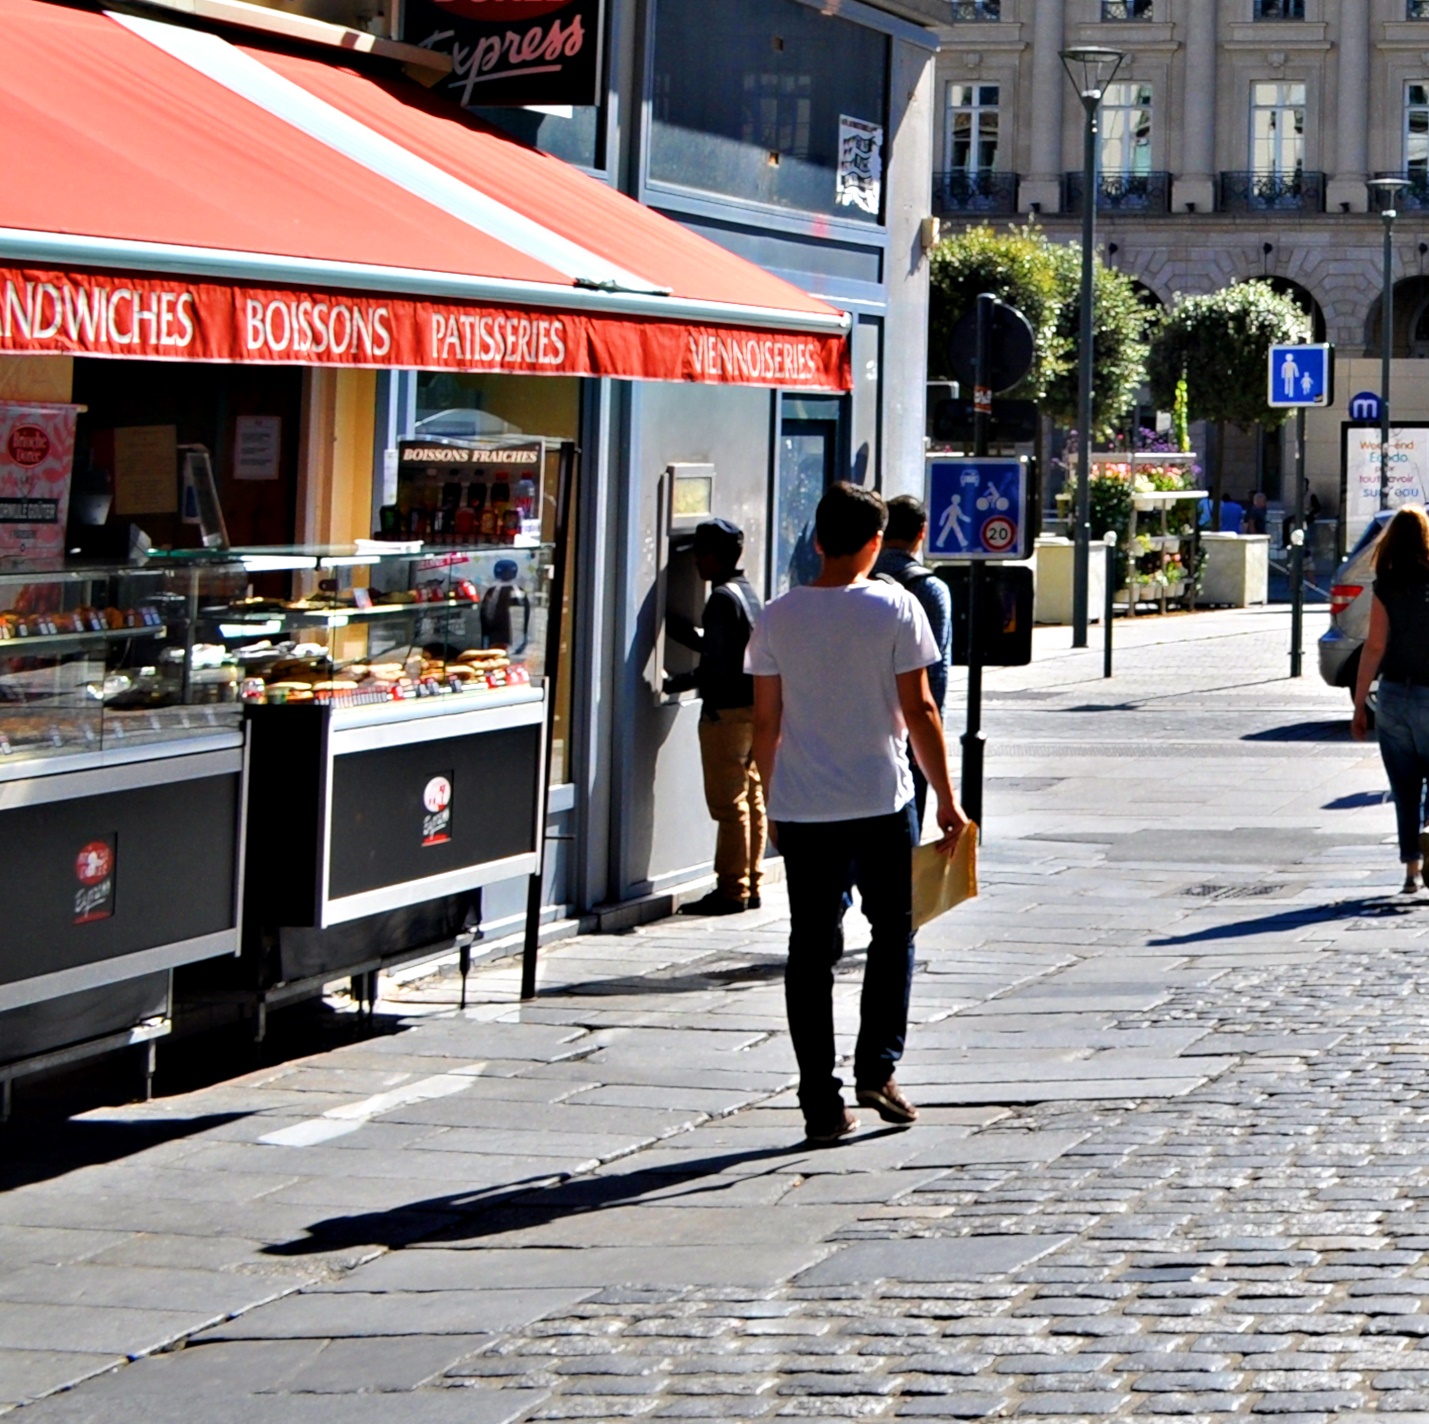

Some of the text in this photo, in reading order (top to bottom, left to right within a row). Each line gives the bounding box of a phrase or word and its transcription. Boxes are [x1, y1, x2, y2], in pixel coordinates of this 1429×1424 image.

[0, 280, 817, 380] NDWICHES BOISSONS PATISSERIES VIENNOISERIES
[1360, 440, 1414, 451] Wee-end
[403, 448, 538, 463] BOISSONS FRAICHES
[1385, 475, 1414, 483] avoir
[0, 502, 27, 519] ORMULE
[988, 528, 1008, 540] 20
